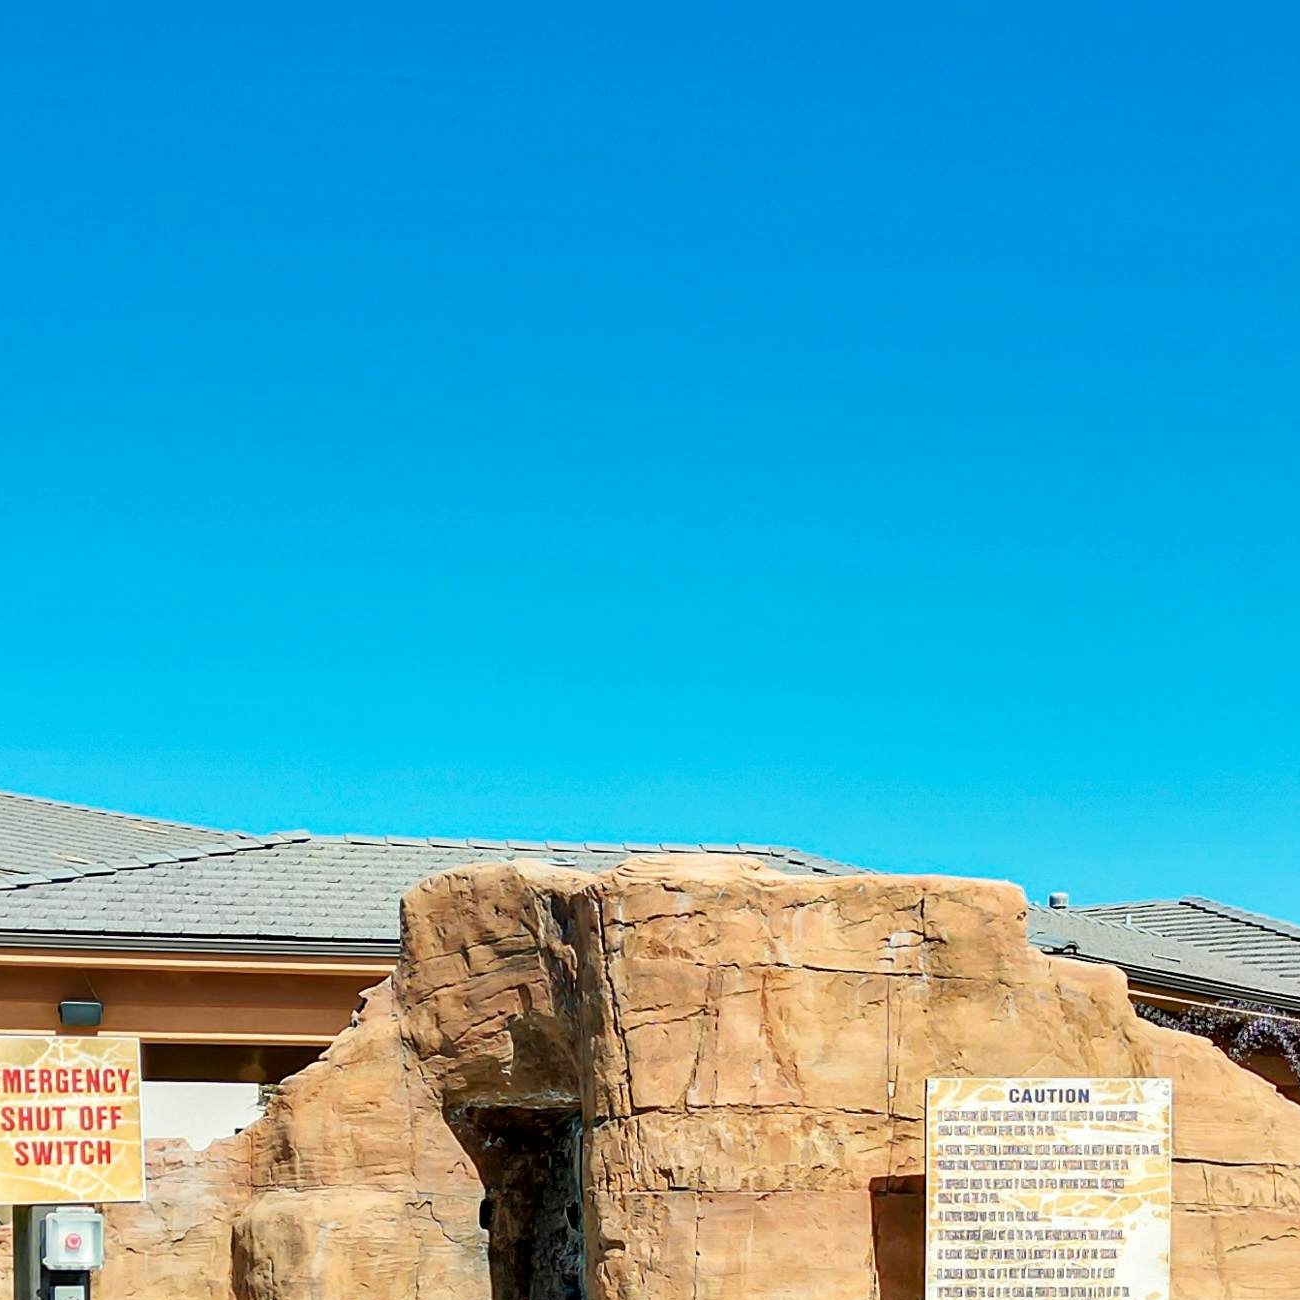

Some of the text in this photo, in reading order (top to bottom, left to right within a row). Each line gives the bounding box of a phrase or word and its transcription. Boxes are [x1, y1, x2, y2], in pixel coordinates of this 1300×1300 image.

[1009, 1088, 1090, 1104] CAUTION
[0, 1105, 122, 1132] SHUT OFF
[14, 1140, 112, 1167] SWITCH
